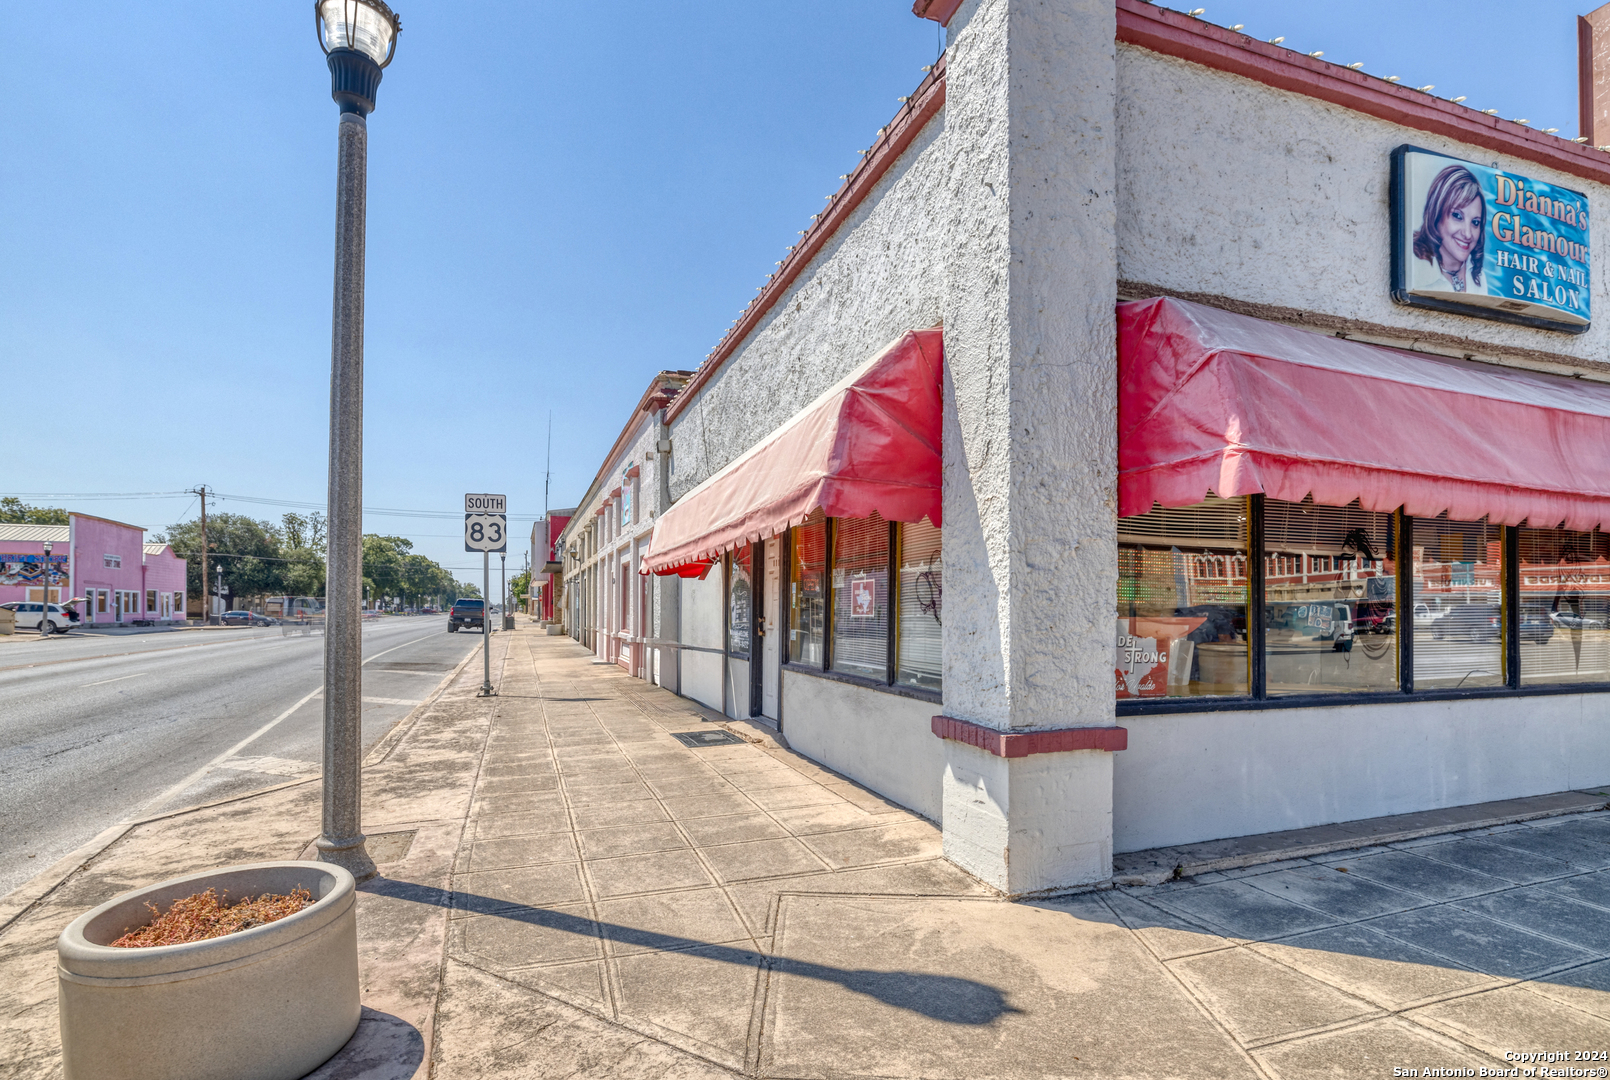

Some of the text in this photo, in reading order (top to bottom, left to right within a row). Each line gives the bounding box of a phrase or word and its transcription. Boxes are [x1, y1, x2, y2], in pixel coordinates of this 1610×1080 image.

[1494, 174, 1587, 231] Dianna's
[1491, 211, 1589, 263] Glamour
[1496, 250, 1588, 288] HAIR & NAIL
[1513, 275, 1580, 310] SALON
[468, 498, 503, 509] SOUTH
[470, 522, 502, 542] 83
